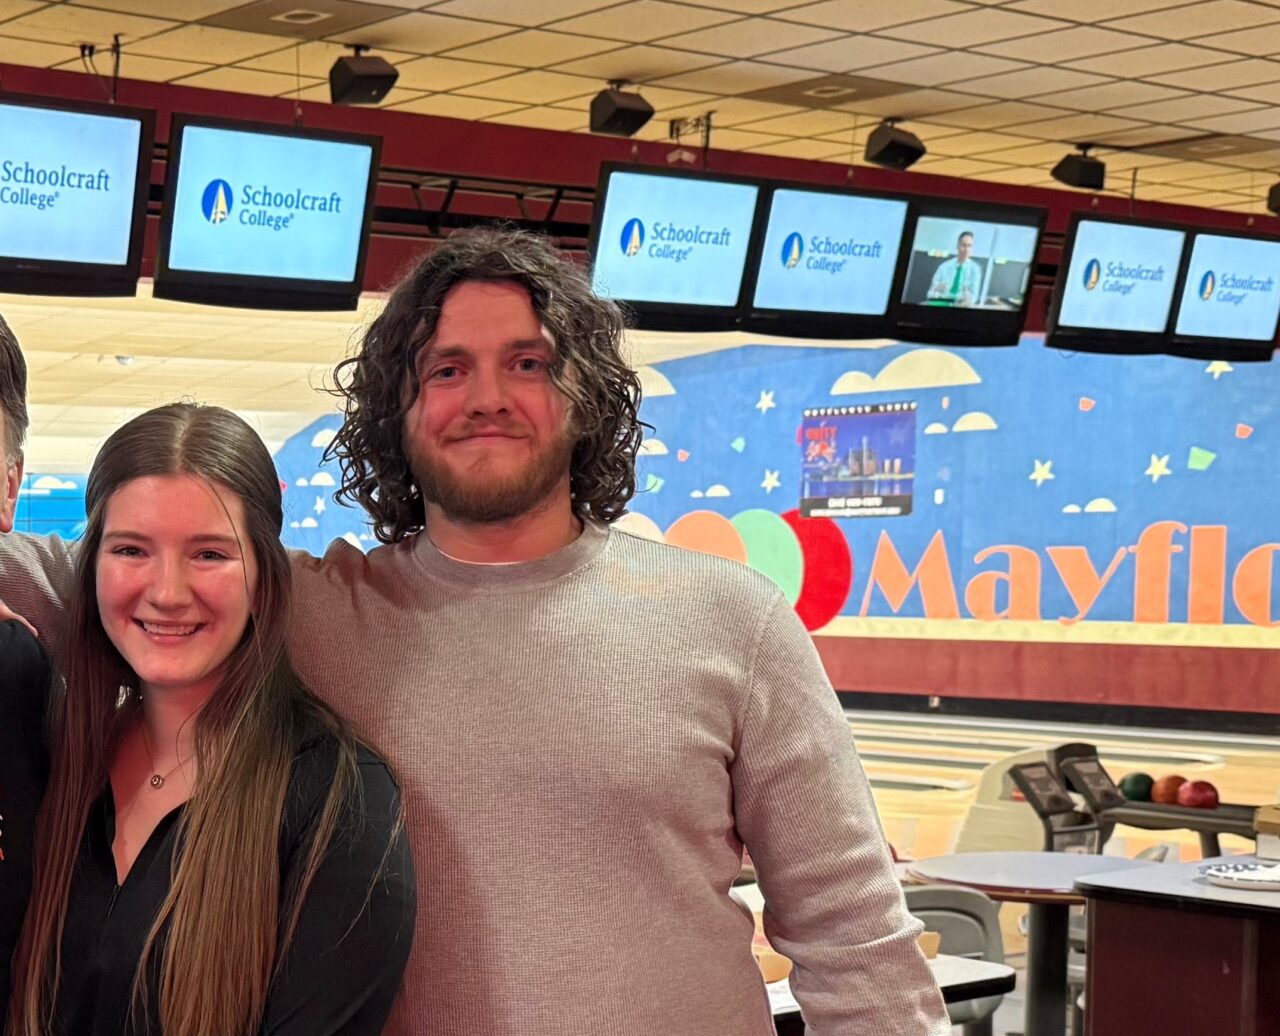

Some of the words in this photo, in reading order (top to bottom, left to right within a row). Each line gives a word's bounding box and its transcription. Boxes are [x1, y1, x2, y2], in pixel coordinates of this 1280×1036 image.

[1, 160, 110, 192] Schoolcraft
[241, 184, 342, 214] Schoolcraft
[651, 221, 731, 246] Schoolcraft
[809, 236, 882, 258] Schoolcraft
